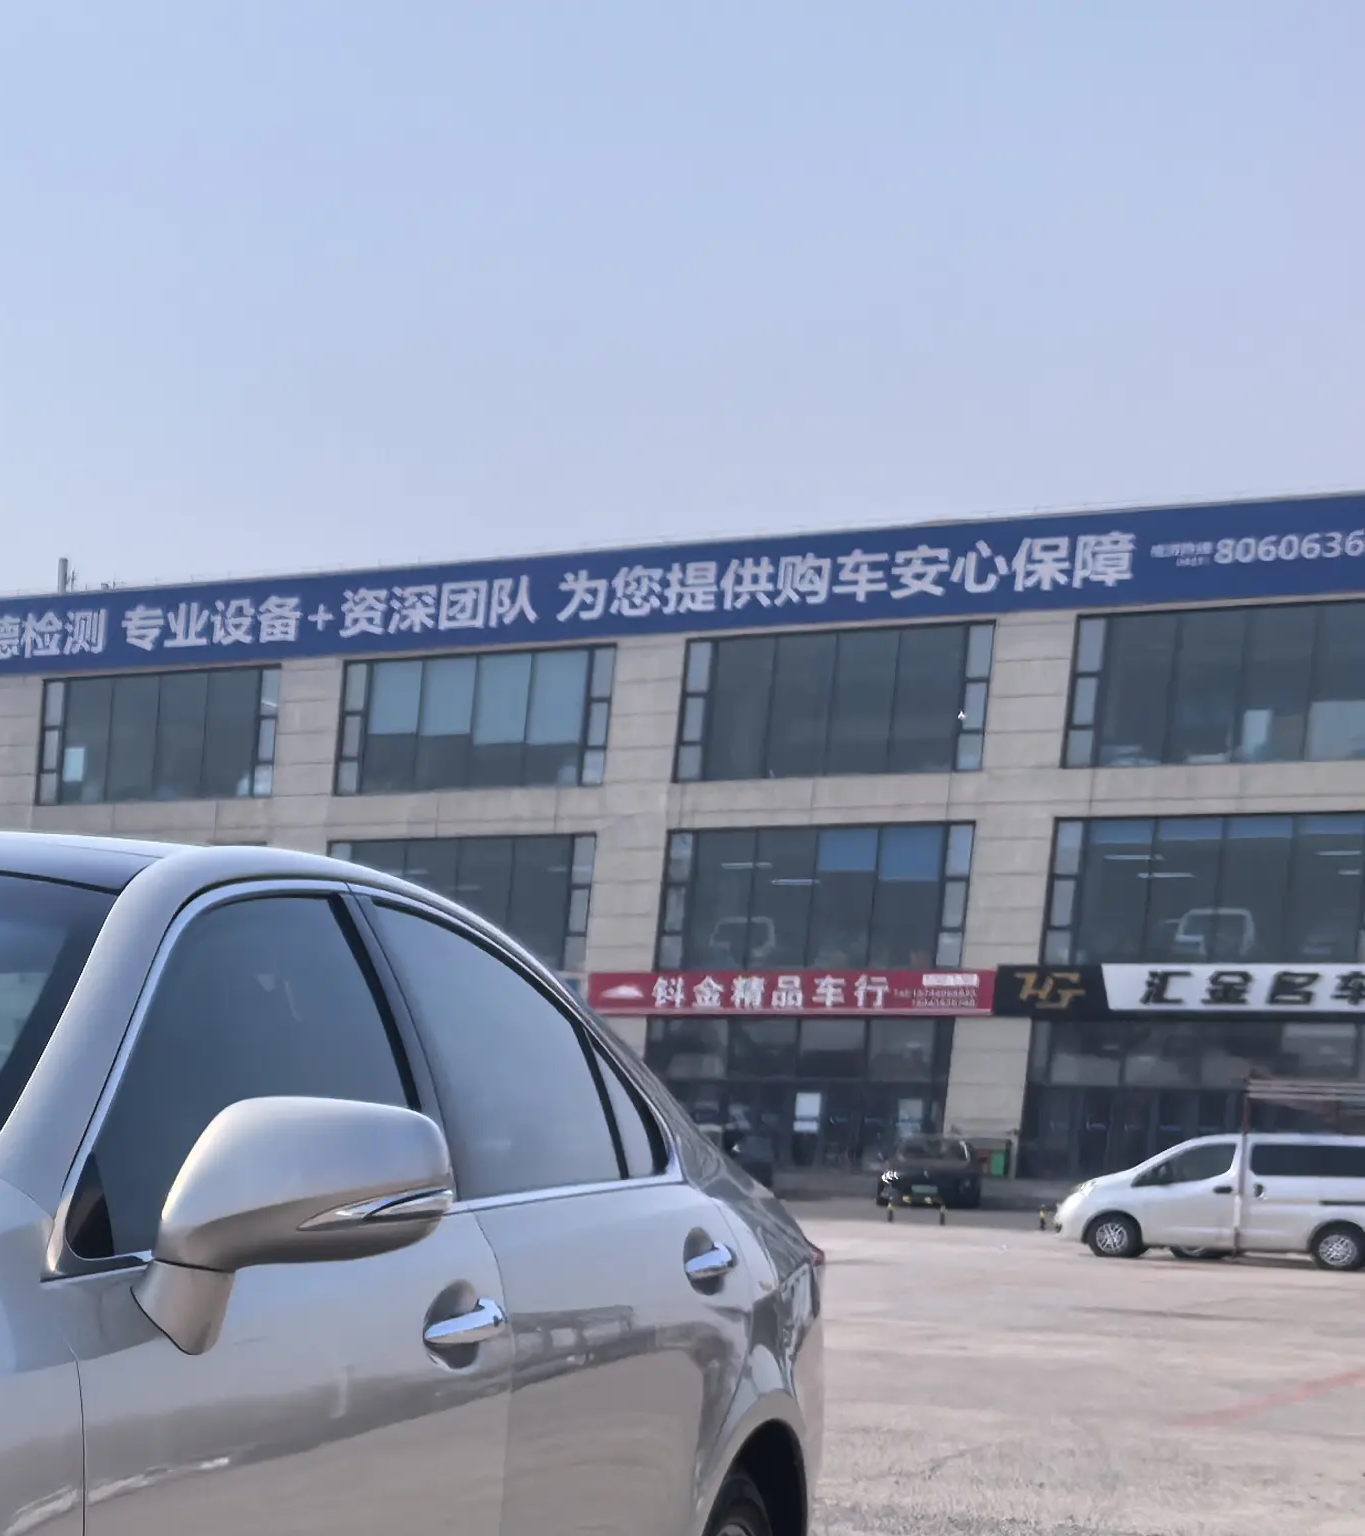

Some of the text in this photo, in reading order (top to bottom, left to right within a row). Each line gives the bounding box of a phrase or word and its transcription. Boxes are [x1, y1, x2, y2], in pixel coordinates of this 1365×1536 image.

[122, 574, 538, 651] 专业设备+资深团队
[556, 530, 1137, 622] 为您提供购车安心保障
[1214, 528, 1365, 564] 8060636
